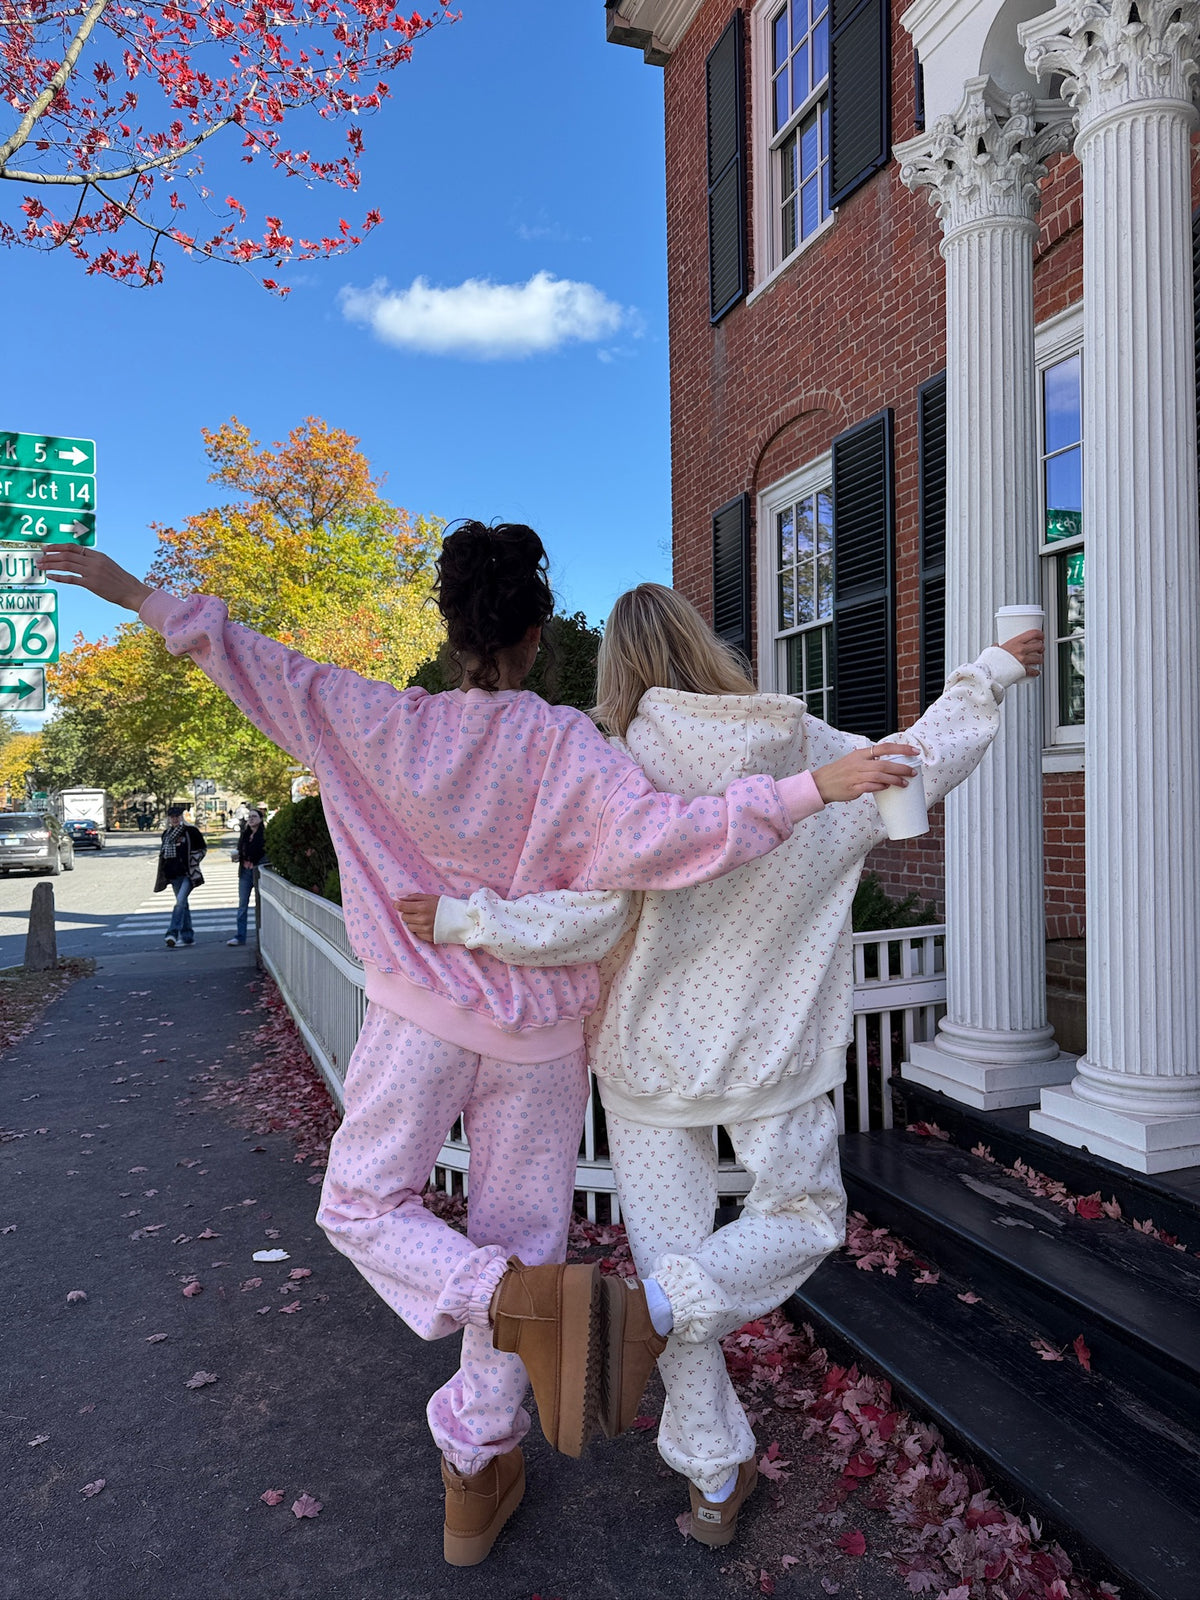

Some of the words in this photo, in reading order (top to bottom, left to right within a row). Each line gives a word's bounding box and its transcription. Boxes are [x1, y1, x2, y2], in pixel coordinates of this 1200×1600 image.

[35, 443, 47, 463] 5
[26, 479, 58, 500] Jct
[69, 483, 90, 503] 14
[20, 515, 48, 536] 26
[0, 617, 48, 655] 06
